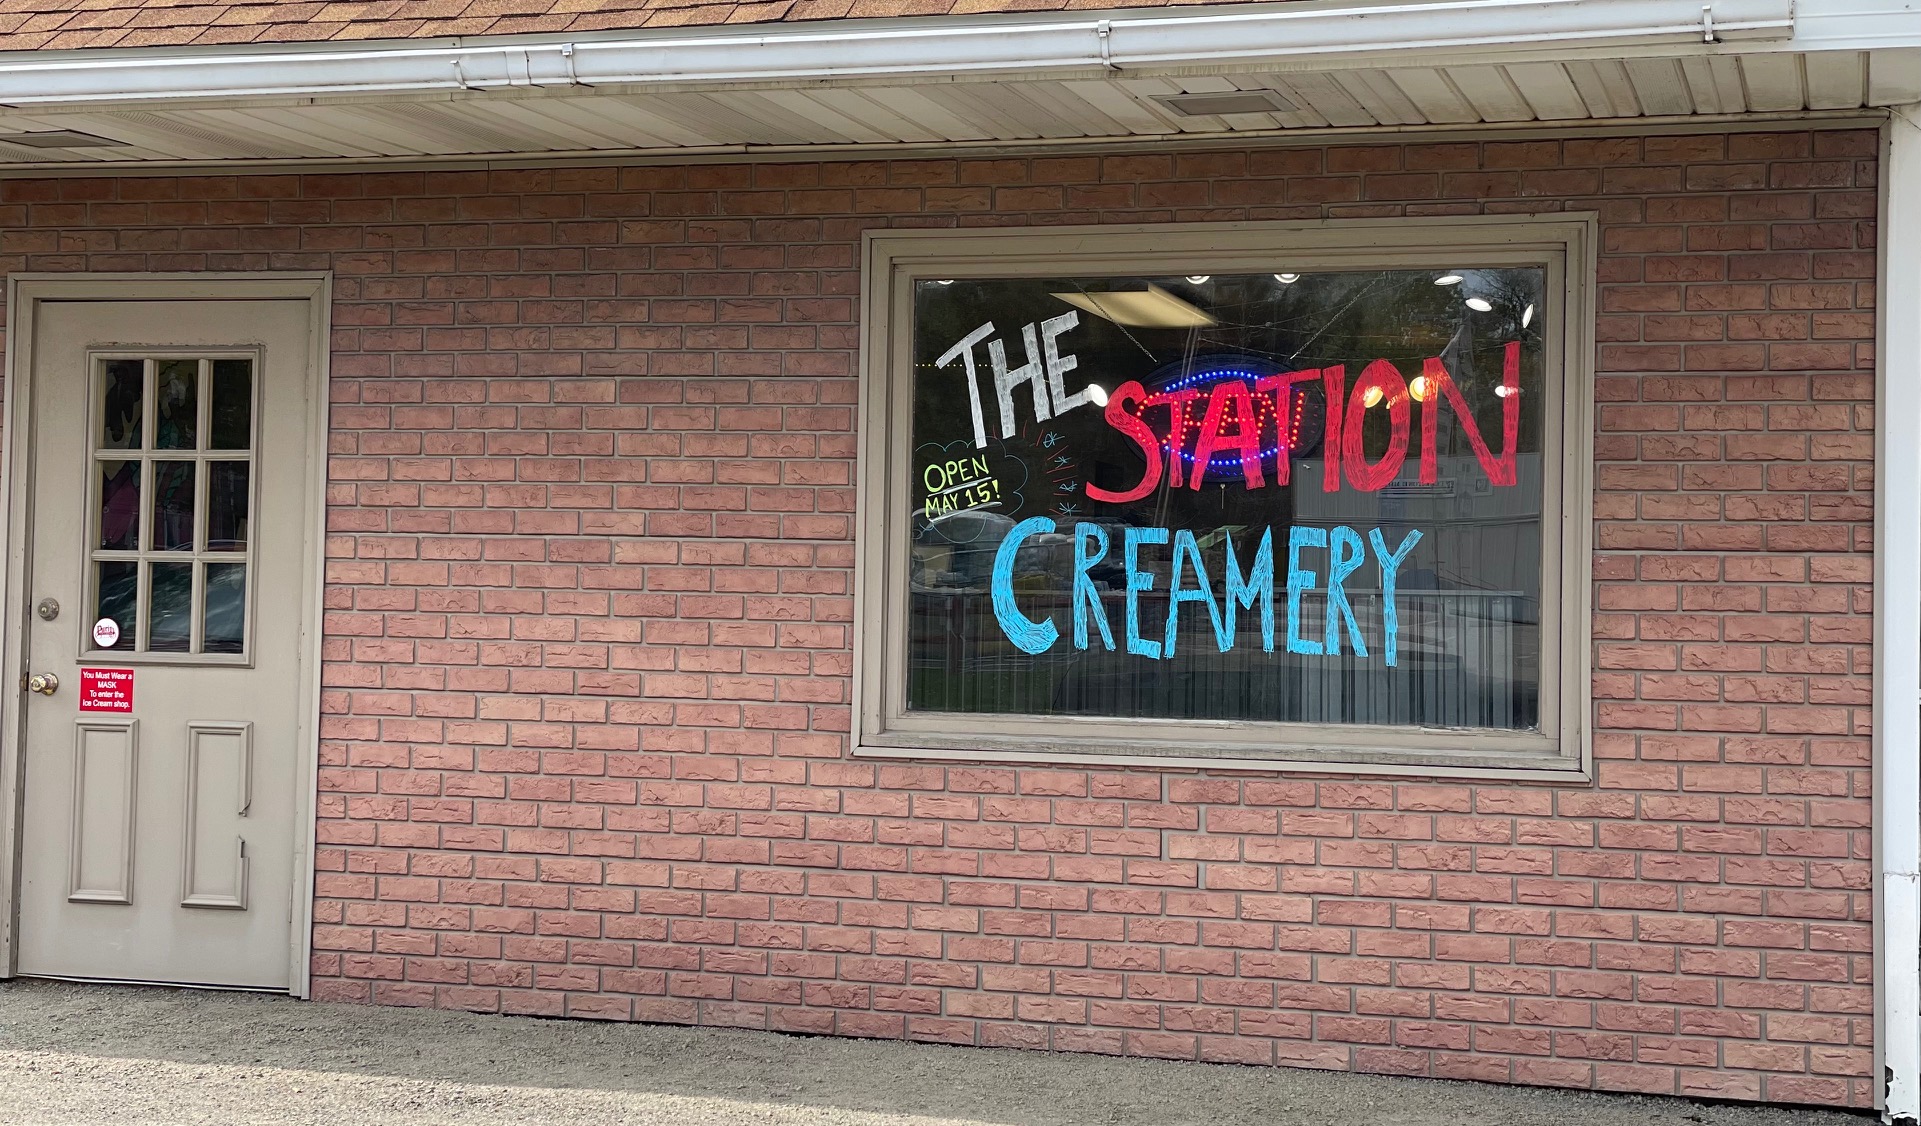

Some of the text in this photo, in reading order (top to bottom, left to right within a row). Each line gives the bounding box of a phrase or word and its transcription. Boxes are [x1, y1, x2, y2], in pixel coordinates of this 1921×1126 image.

[935, 311, 1097, 448] THE
[1085, 341, 1520, 503] STATION
[924, 454, 989, 492] OPEN
[925, 479, 1001, 519] MAY 15!
[991, 516, 1424, 667] CREAMERY
[83, 671, 94, 679] You
[111, 672, 127, 680] Wear
[90, 690, 97, 698] To
[114, 691, 125, 699] the
[98, 681, 117, 689] MASK
[82, 699, 130, 710] Ice Cream shop.
